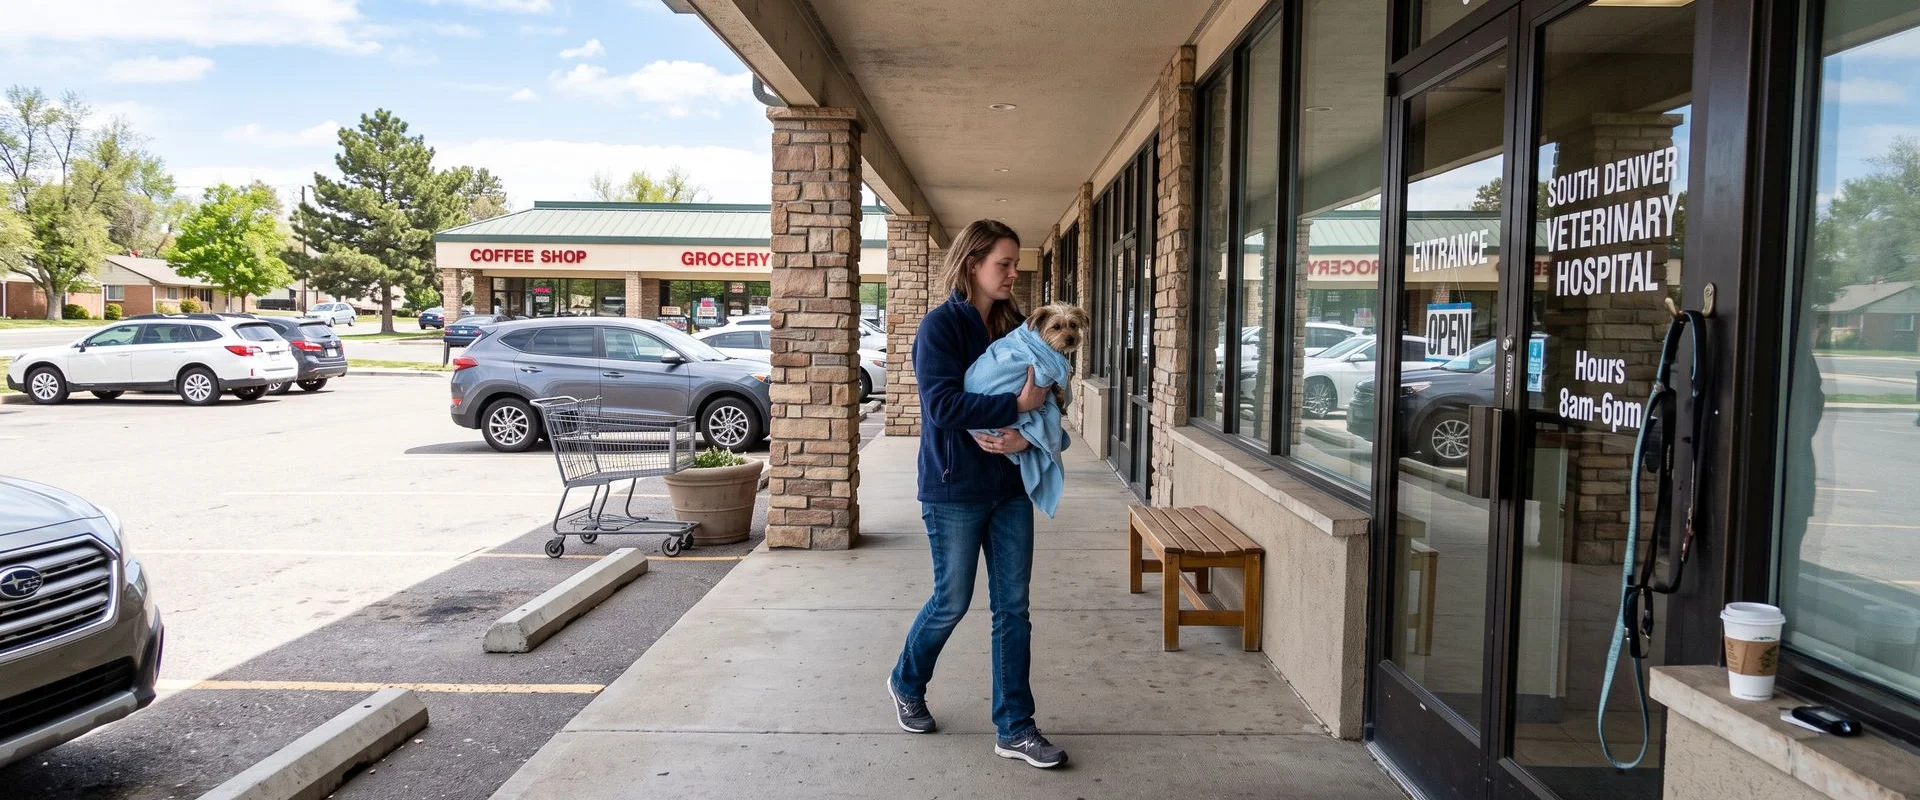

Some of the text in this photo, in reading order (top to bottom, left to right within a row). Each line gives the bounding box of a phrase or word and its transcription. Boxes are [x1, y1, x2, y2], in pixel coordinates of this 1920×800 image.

[1547, 146, 1678, 208] SOUTH DENVER
[1546, 193, 1679, 252] VETERINARY
[470, 248, 587, 264] COFFEE SHOP
[681, 251, 771, 267] GROCERY
[1412, 228, 1489, 273] ENTRANCE
[1556, 250, 1659, 297] HOSPITAL
[1427, 313, 1469, 356] OPEN
[1575, 349, 1626, 384] Hours
[1558, 387, 1642, 433] 8am-6pm
